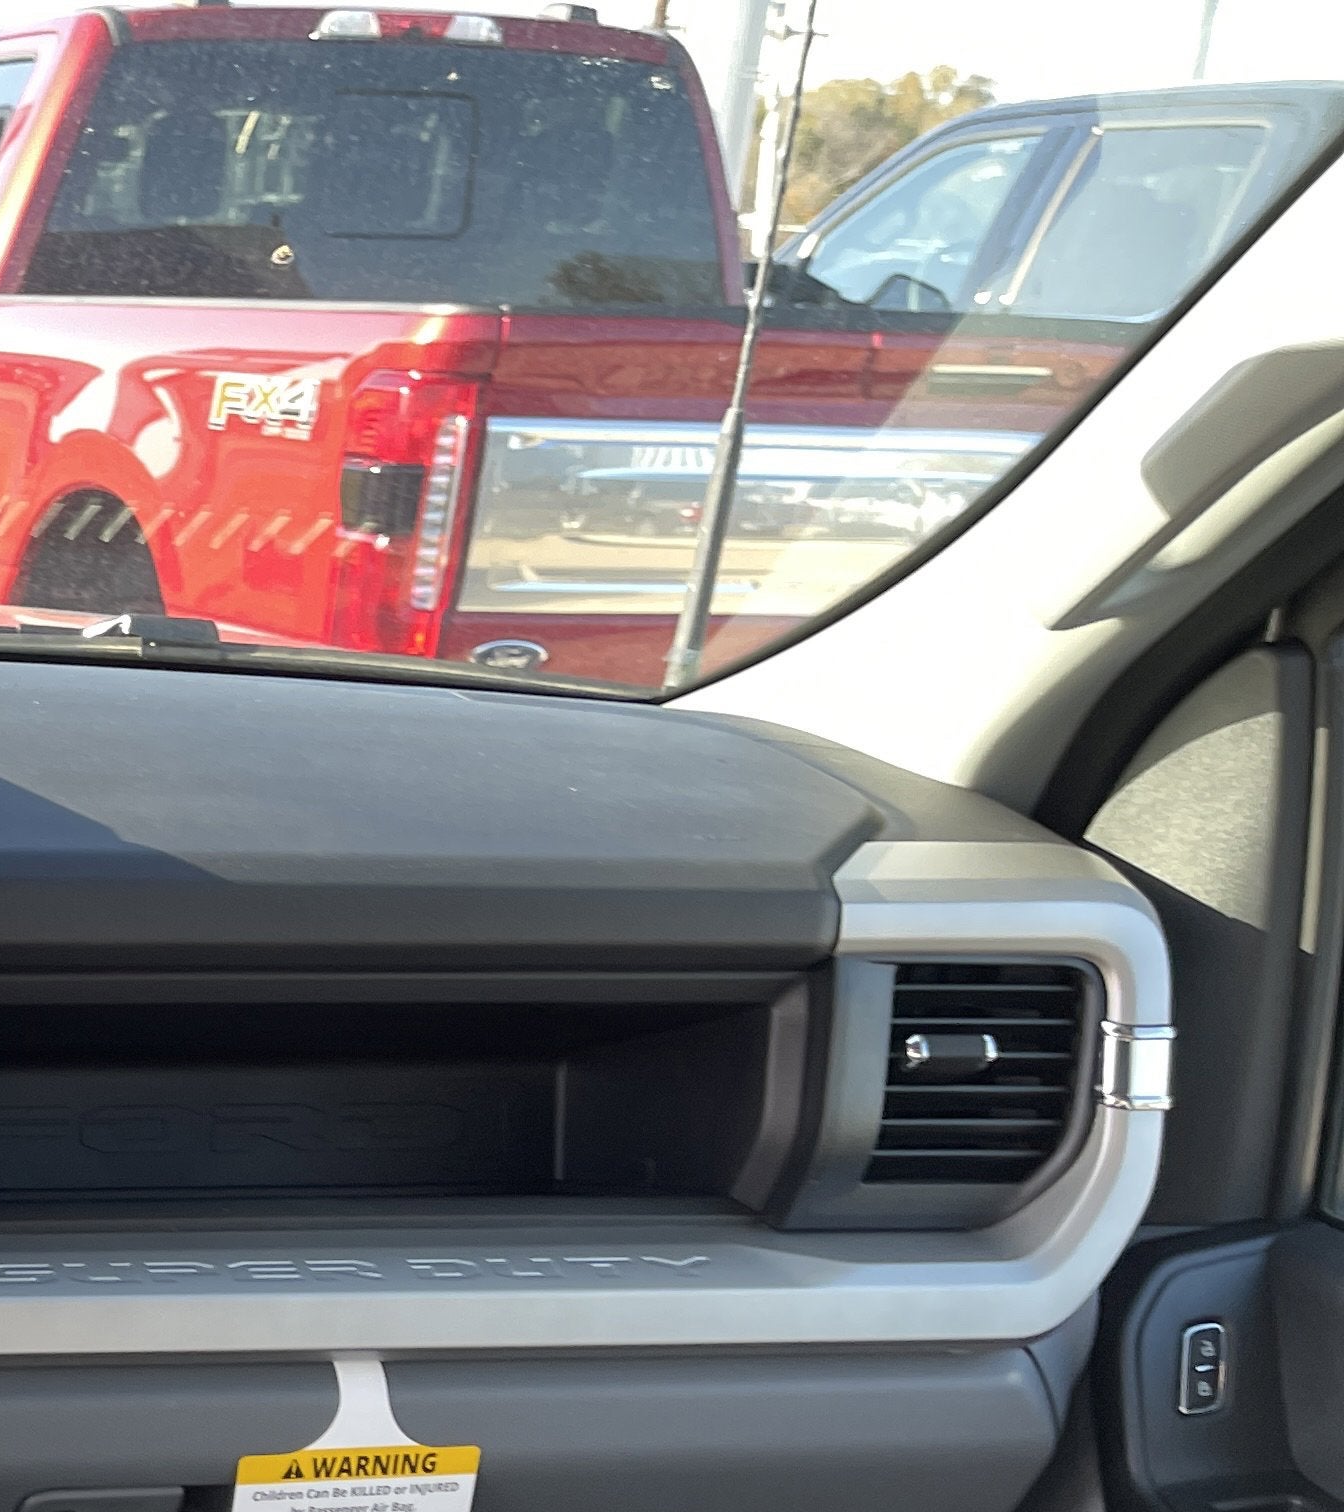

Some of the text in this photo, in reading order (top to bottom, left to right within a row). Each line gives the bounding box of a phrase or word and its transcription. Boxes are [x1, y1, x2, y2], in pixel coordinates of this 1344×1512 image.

[207, 372, 320, 431] FX4
[405, 1255, 711, 1280] DUTY
[312, 1452, 439, 1479] WARNING
[252, 1490, 304, 1501] Children
[306, 1488, 330, 1499] Can
[332, 1487, 348, 1498] Be
[350, 1485, 392, 1497] KILLED
[409, 1482, 460, 1496] INJURED
[372, 1502, 389, 1512] Air
